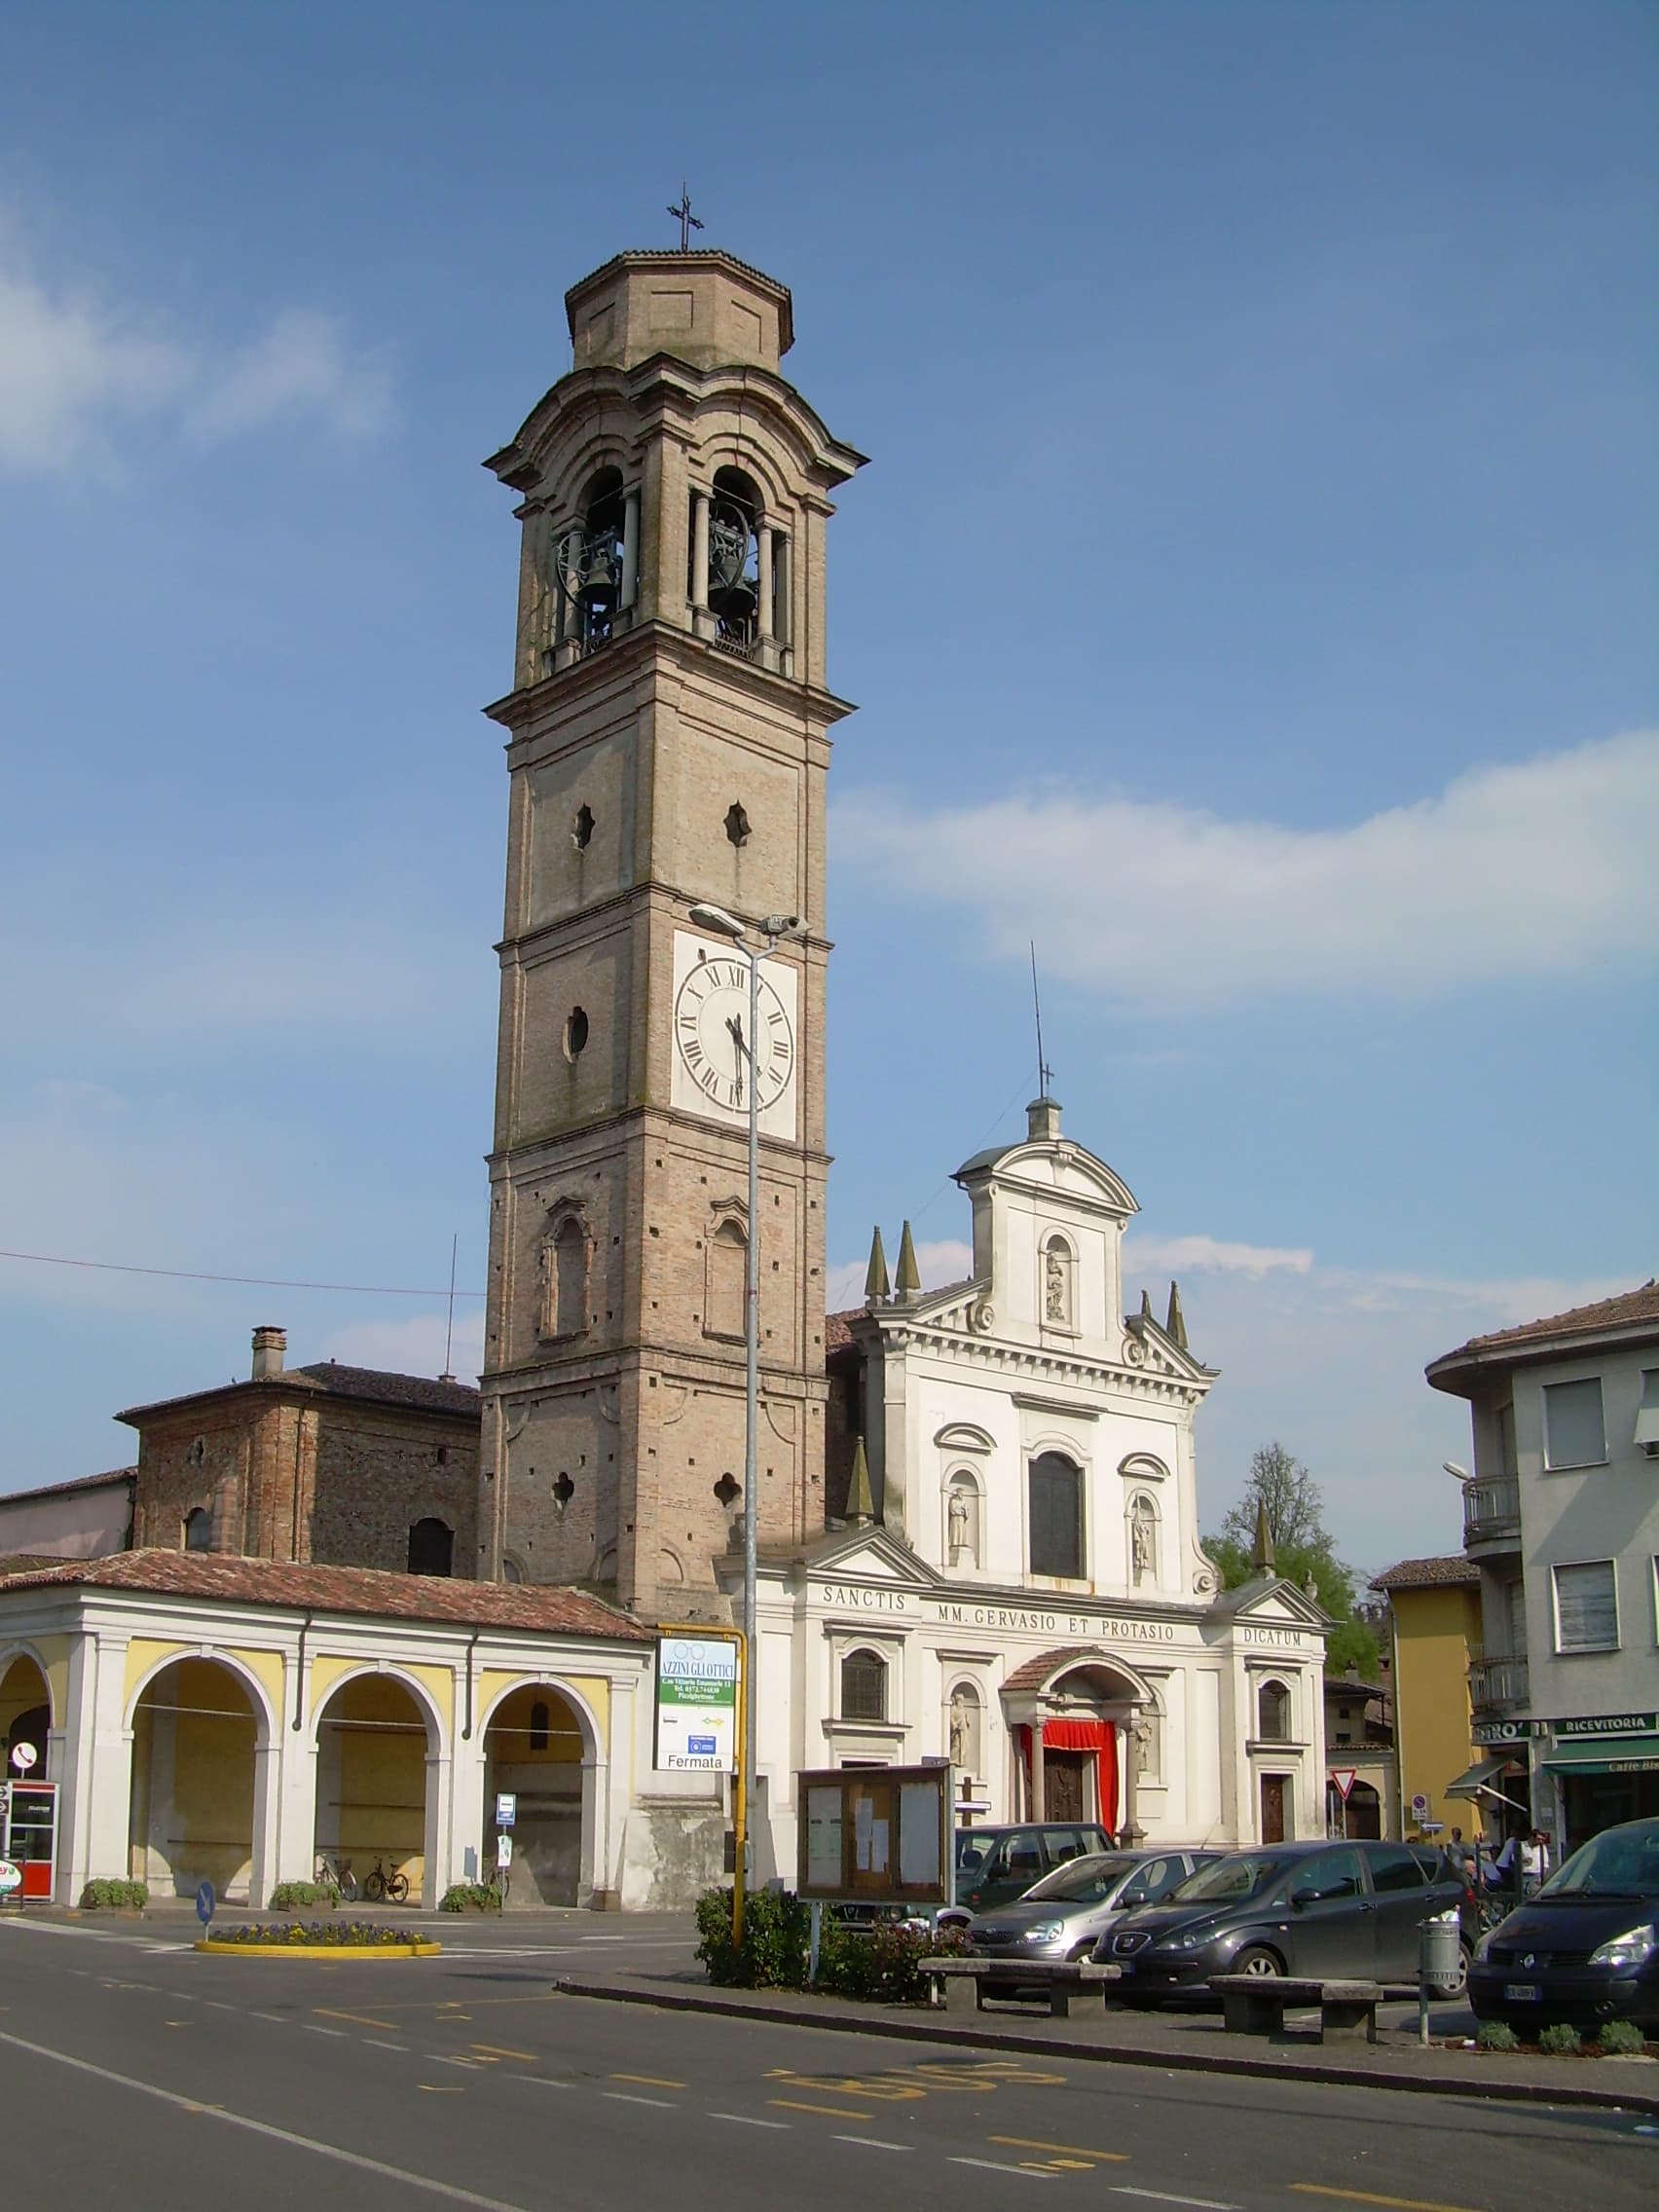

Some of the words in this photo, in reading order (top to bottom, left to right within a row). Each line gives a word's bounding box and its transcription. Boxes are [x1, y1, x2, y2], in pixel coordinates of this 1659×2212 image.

[823, 1586, 905, 1610] SANCTIS
[938, 1604, 969, 1623] MM.
[975, 1608, 1056, 1630] GERVASIO
[1069, 1617, 1088, 1633] ET
[1102, 1620, 1174, 1640] PROTASIO
[1244, 1628, 1302, 1646] DICATUM
[662, 1661, 689, 1675] AZZINI
[691, 1662, 705, 1676] GLI
[707, 1663, 733, 1677] OTTICI
[1567, 1717, 1645, 1732] RICEVITORIA
[668, 1754, 722, 1769] Fermata
[781, 2062, 1067, 2100] BUS
